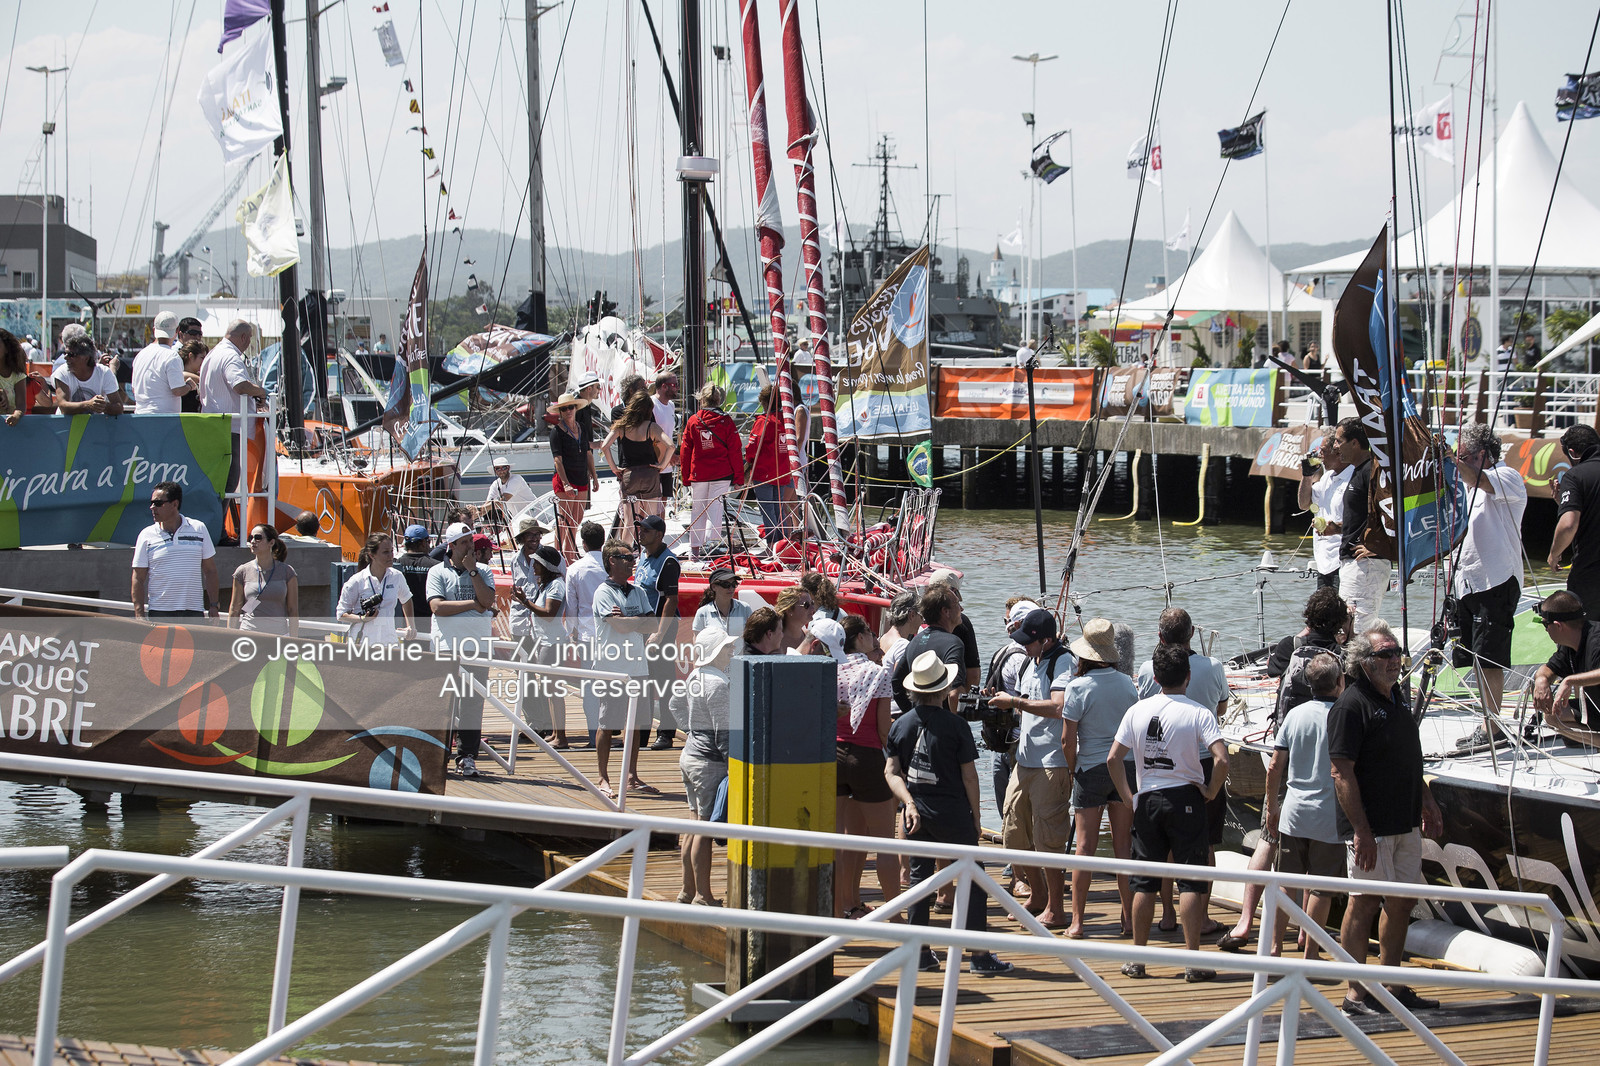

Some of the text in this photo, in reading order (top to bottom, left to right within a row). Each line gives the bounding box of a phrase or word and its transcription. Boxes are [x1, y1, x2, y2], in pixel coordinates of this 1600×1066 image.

[1243, 384, 1265, 396] PELOS
[1239, 397, 1266, 409] MUNDO
[22, 468, 89, 511] para
[97, 465, 114, 488] a
[122, 445, 189, 486] terra
